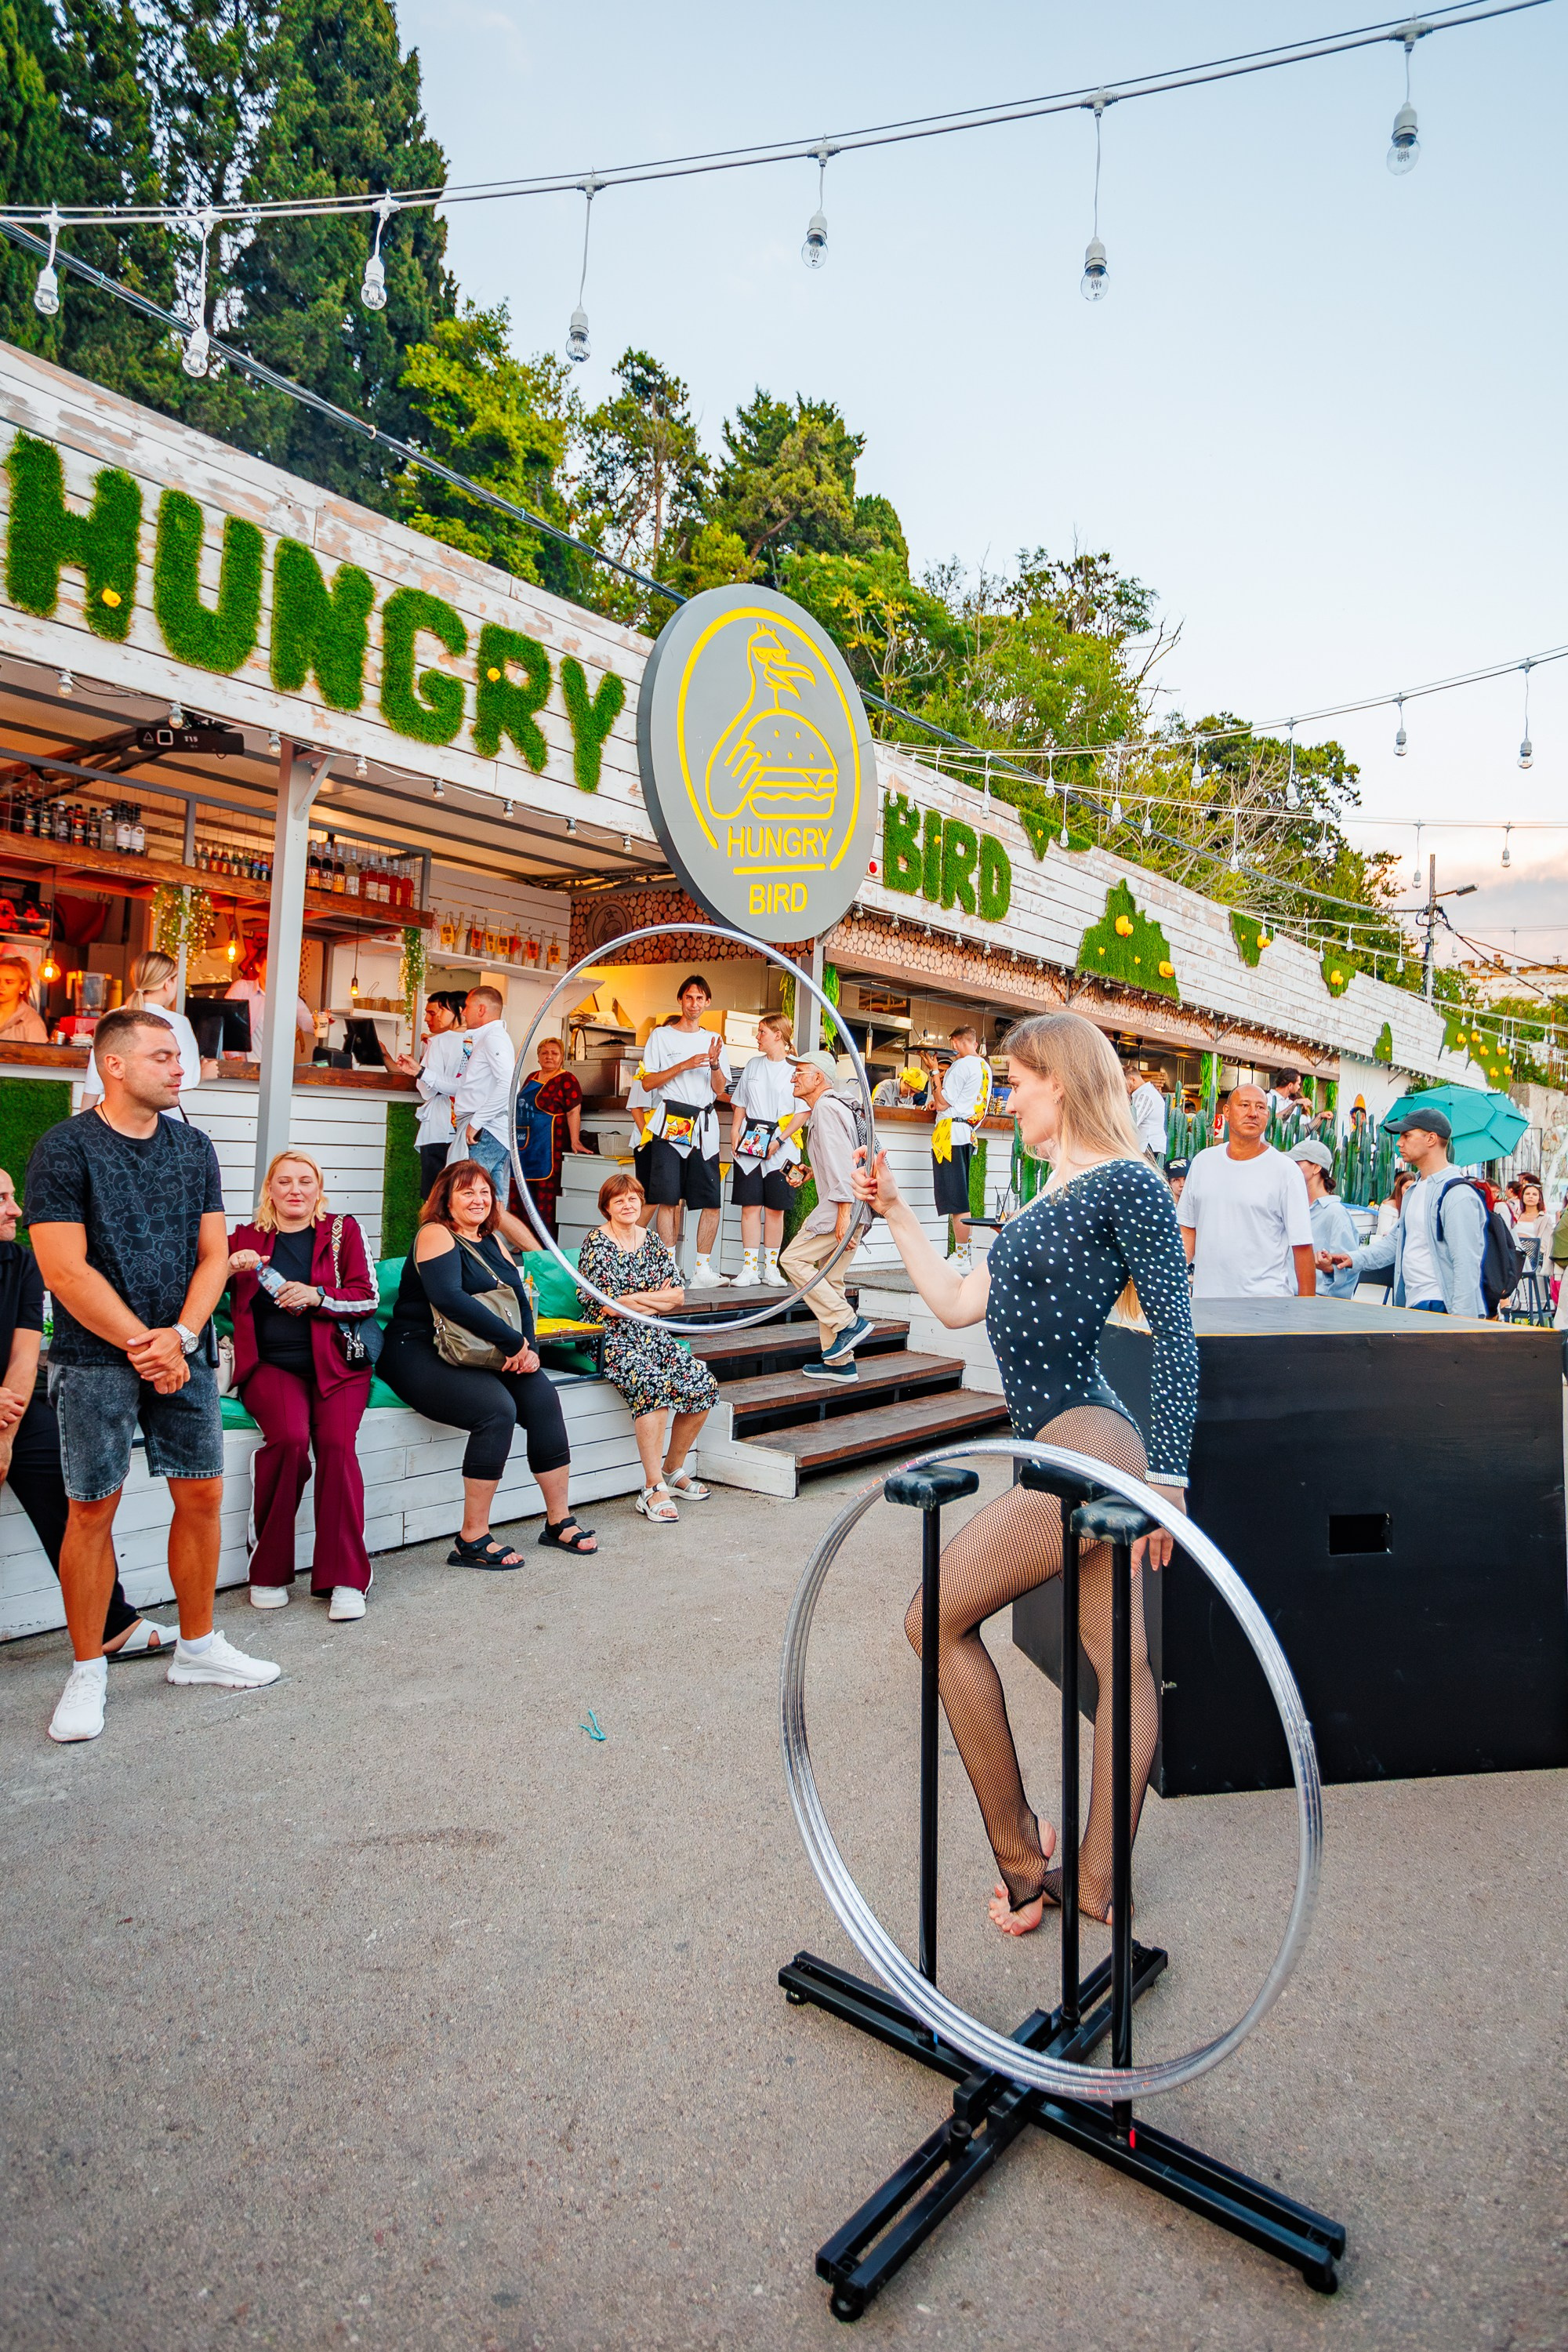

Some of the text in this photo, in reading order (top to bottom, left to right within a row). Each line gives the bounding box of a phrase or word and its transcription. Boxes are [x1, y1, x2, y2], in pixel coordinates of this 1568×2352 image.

[3, 429, 1012, 922] HUNGRY BIRD
[727, 826, 833, 858] HUNGRY
[749, 882, 808, 915] BIRD
